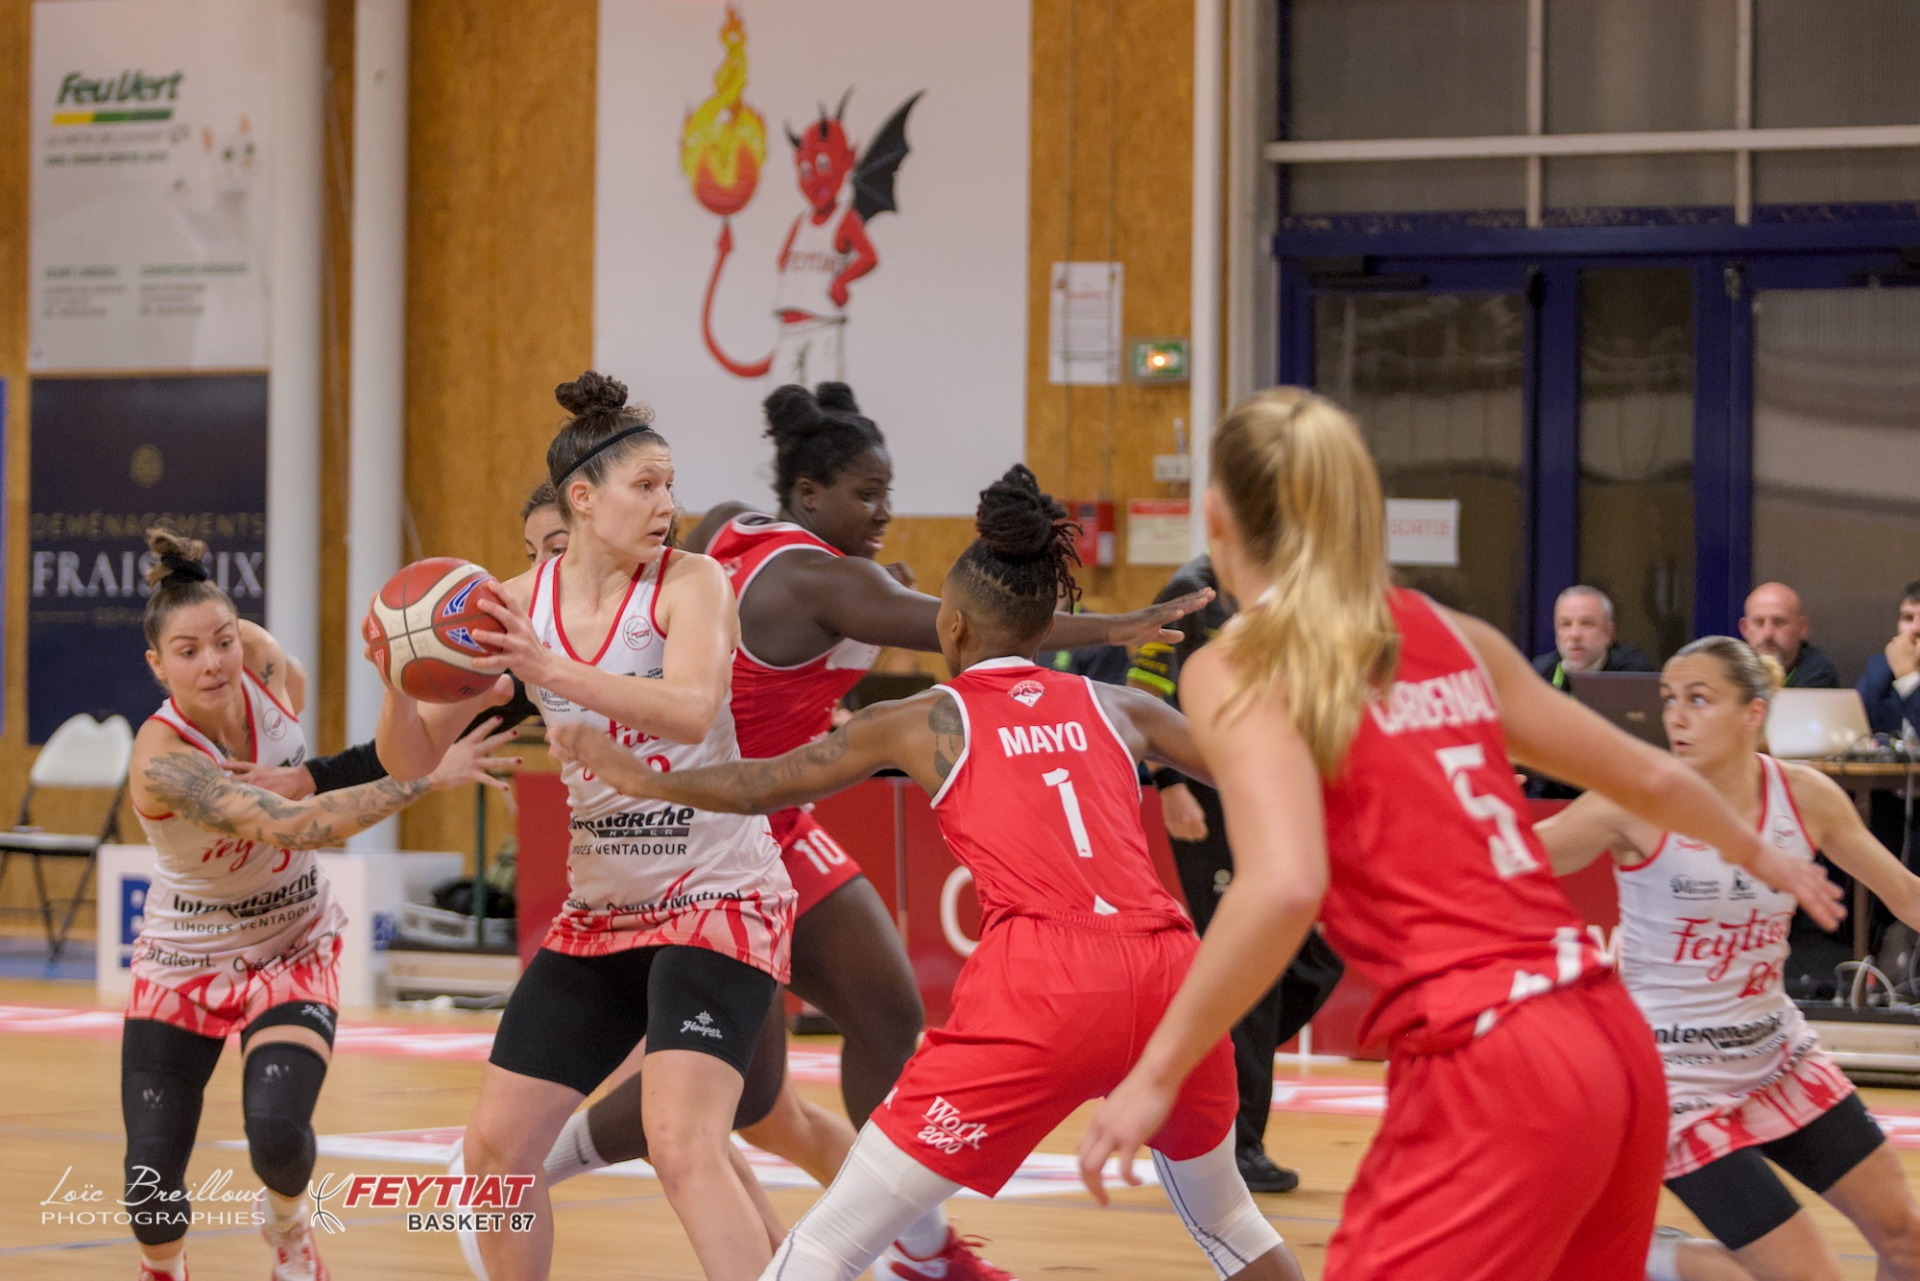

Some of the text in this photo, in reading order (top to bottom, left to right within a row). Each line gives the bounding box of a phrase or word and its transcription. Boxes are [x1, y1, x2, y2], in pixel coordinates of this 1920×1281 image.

[56, 67, 184, 105] Feu Vert
[1390, 518, 1451, 537] SORTIE
[32, 550, 264, 599] FRAISIX
[997, 720, 1089, 758] MAYO
[1041, 766, 1094, 858] 1
[1434, 742, 1541, 879] 5
[595, 843, 688, 856] VENTADOUR
[609, 828, 675, 837] HYPER
[792, 828, 848, 875] 10
[174, 920, 234, 934] LIMOGES
[917, 1124, 964, 1156] 2000
[924, 1095, 989, 1151] Work
